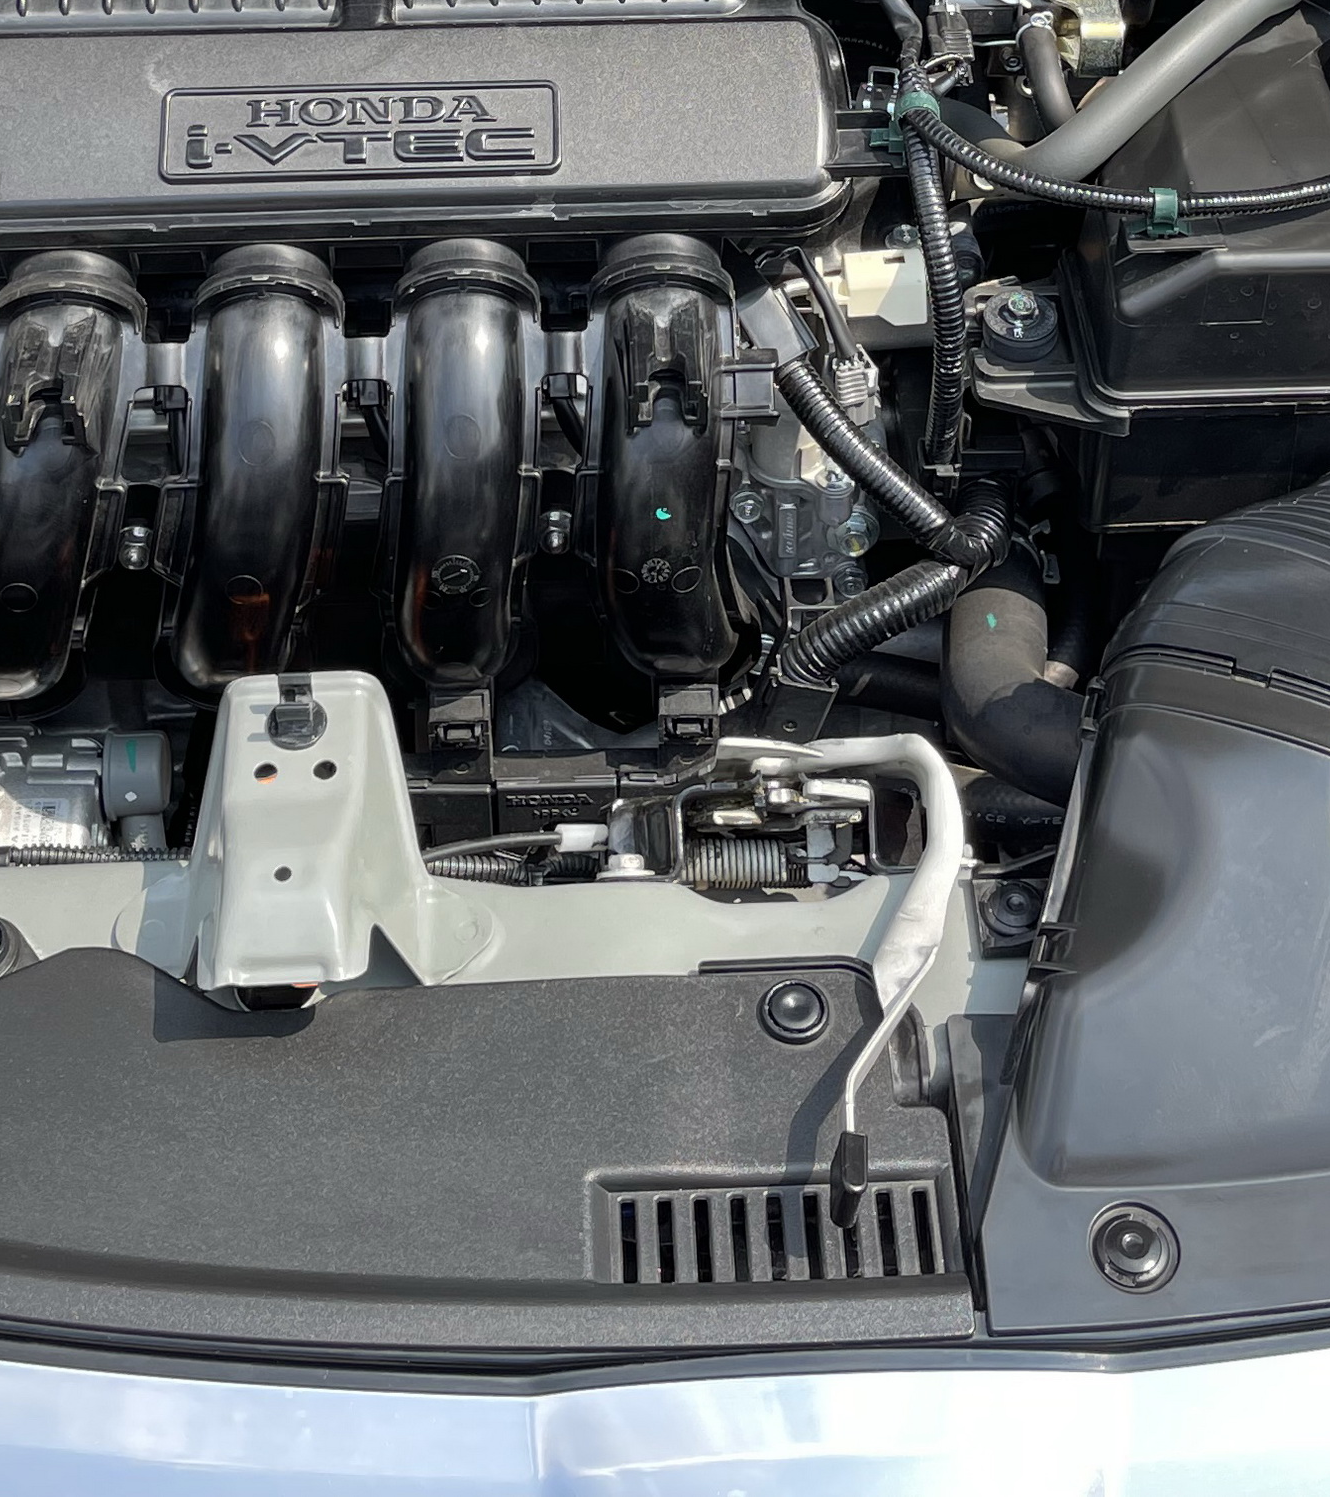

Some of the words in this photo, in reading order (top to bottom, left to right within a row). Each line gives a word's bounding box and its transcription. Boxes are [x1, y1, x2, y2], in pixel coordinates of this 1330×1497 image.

[246, 95, 498, 128] HONDA
[184, 124, 536, 169] i-VTEC
[505, 792, 595, 808] HONDA
